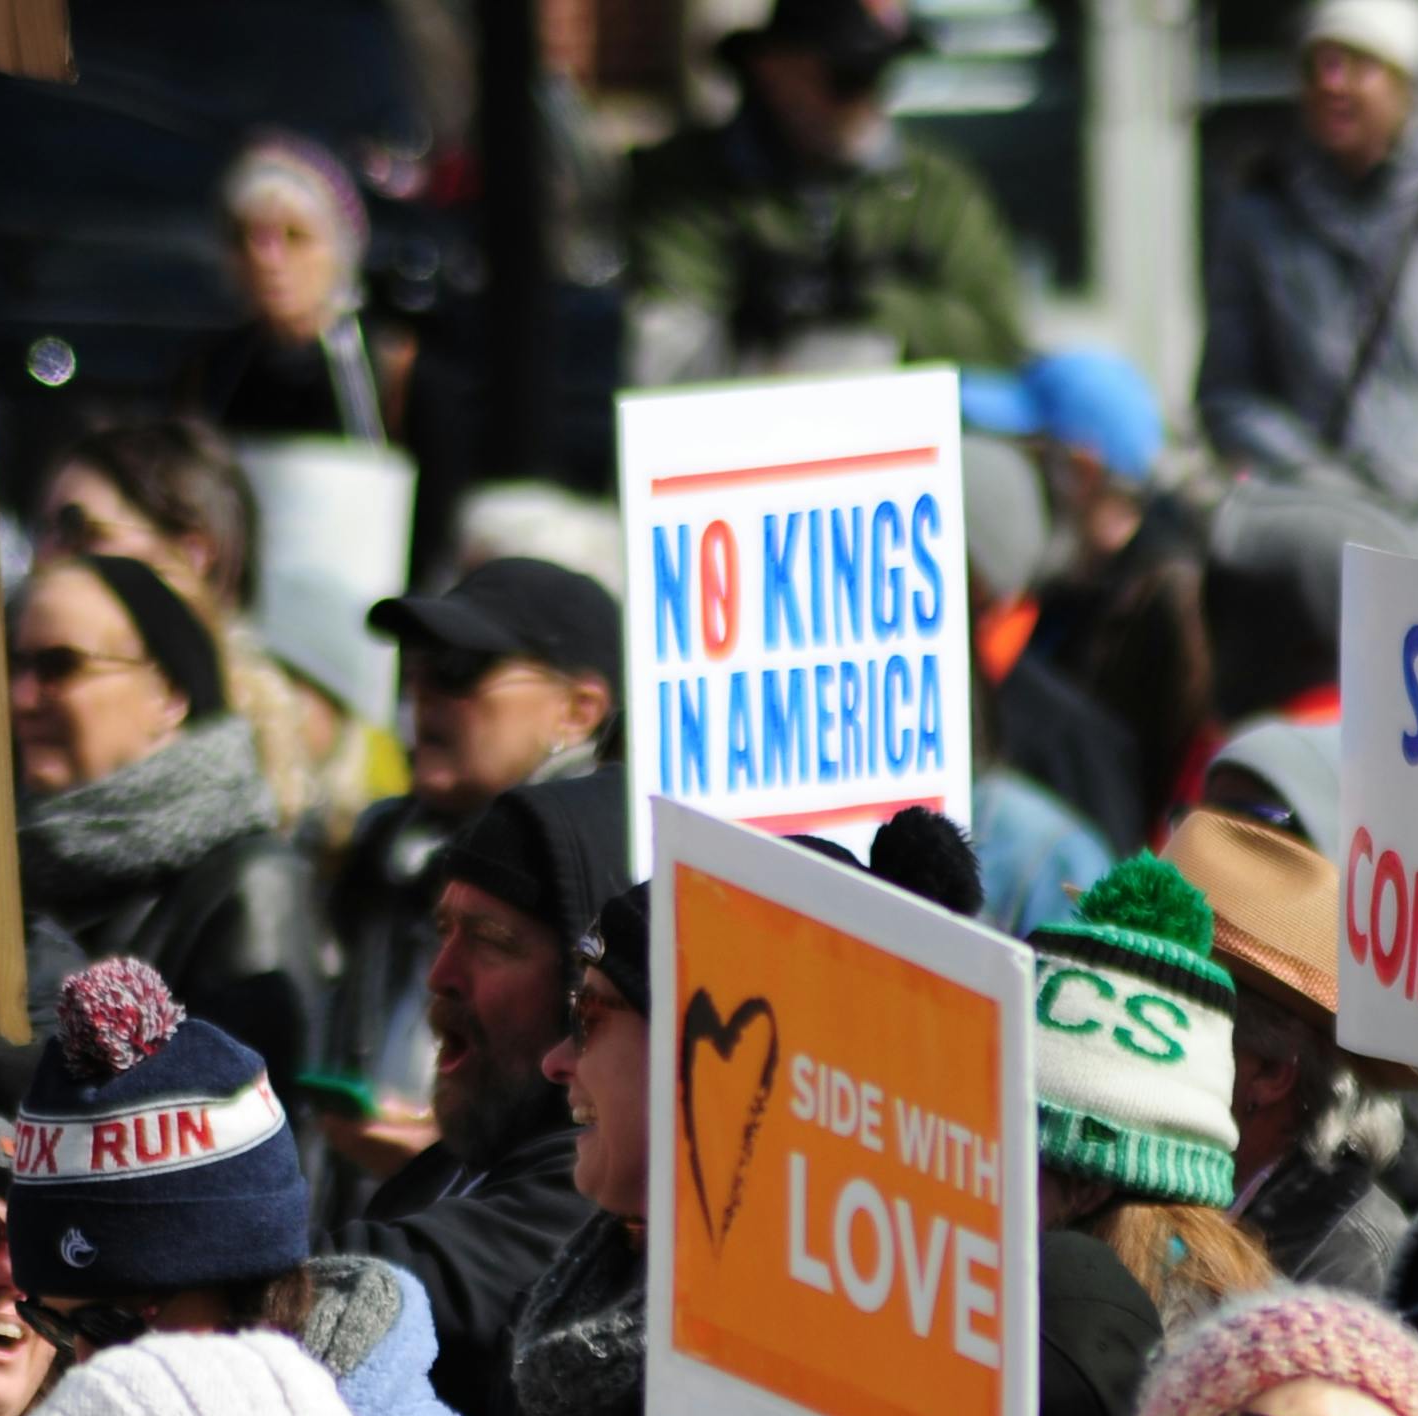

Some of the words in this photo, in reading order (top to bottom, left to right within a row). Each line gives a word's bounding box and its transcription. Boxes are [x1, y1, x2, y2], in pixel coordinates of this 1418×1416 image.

[652, 518, 741, 664] NO
[762, 492, 945, 653] KINGS
[658, 676, 711, 797] IN
[727, 653, 945, 795] AMERICA
[15, 1122, 64, 1174] OX
[89, 1107, 217, 1171] RUN
[789, 1053, 884, 1155] SIDE
[894, 1097, 1000, 1205] WITH
[789, 1151, 1001, 1370] LOVE
